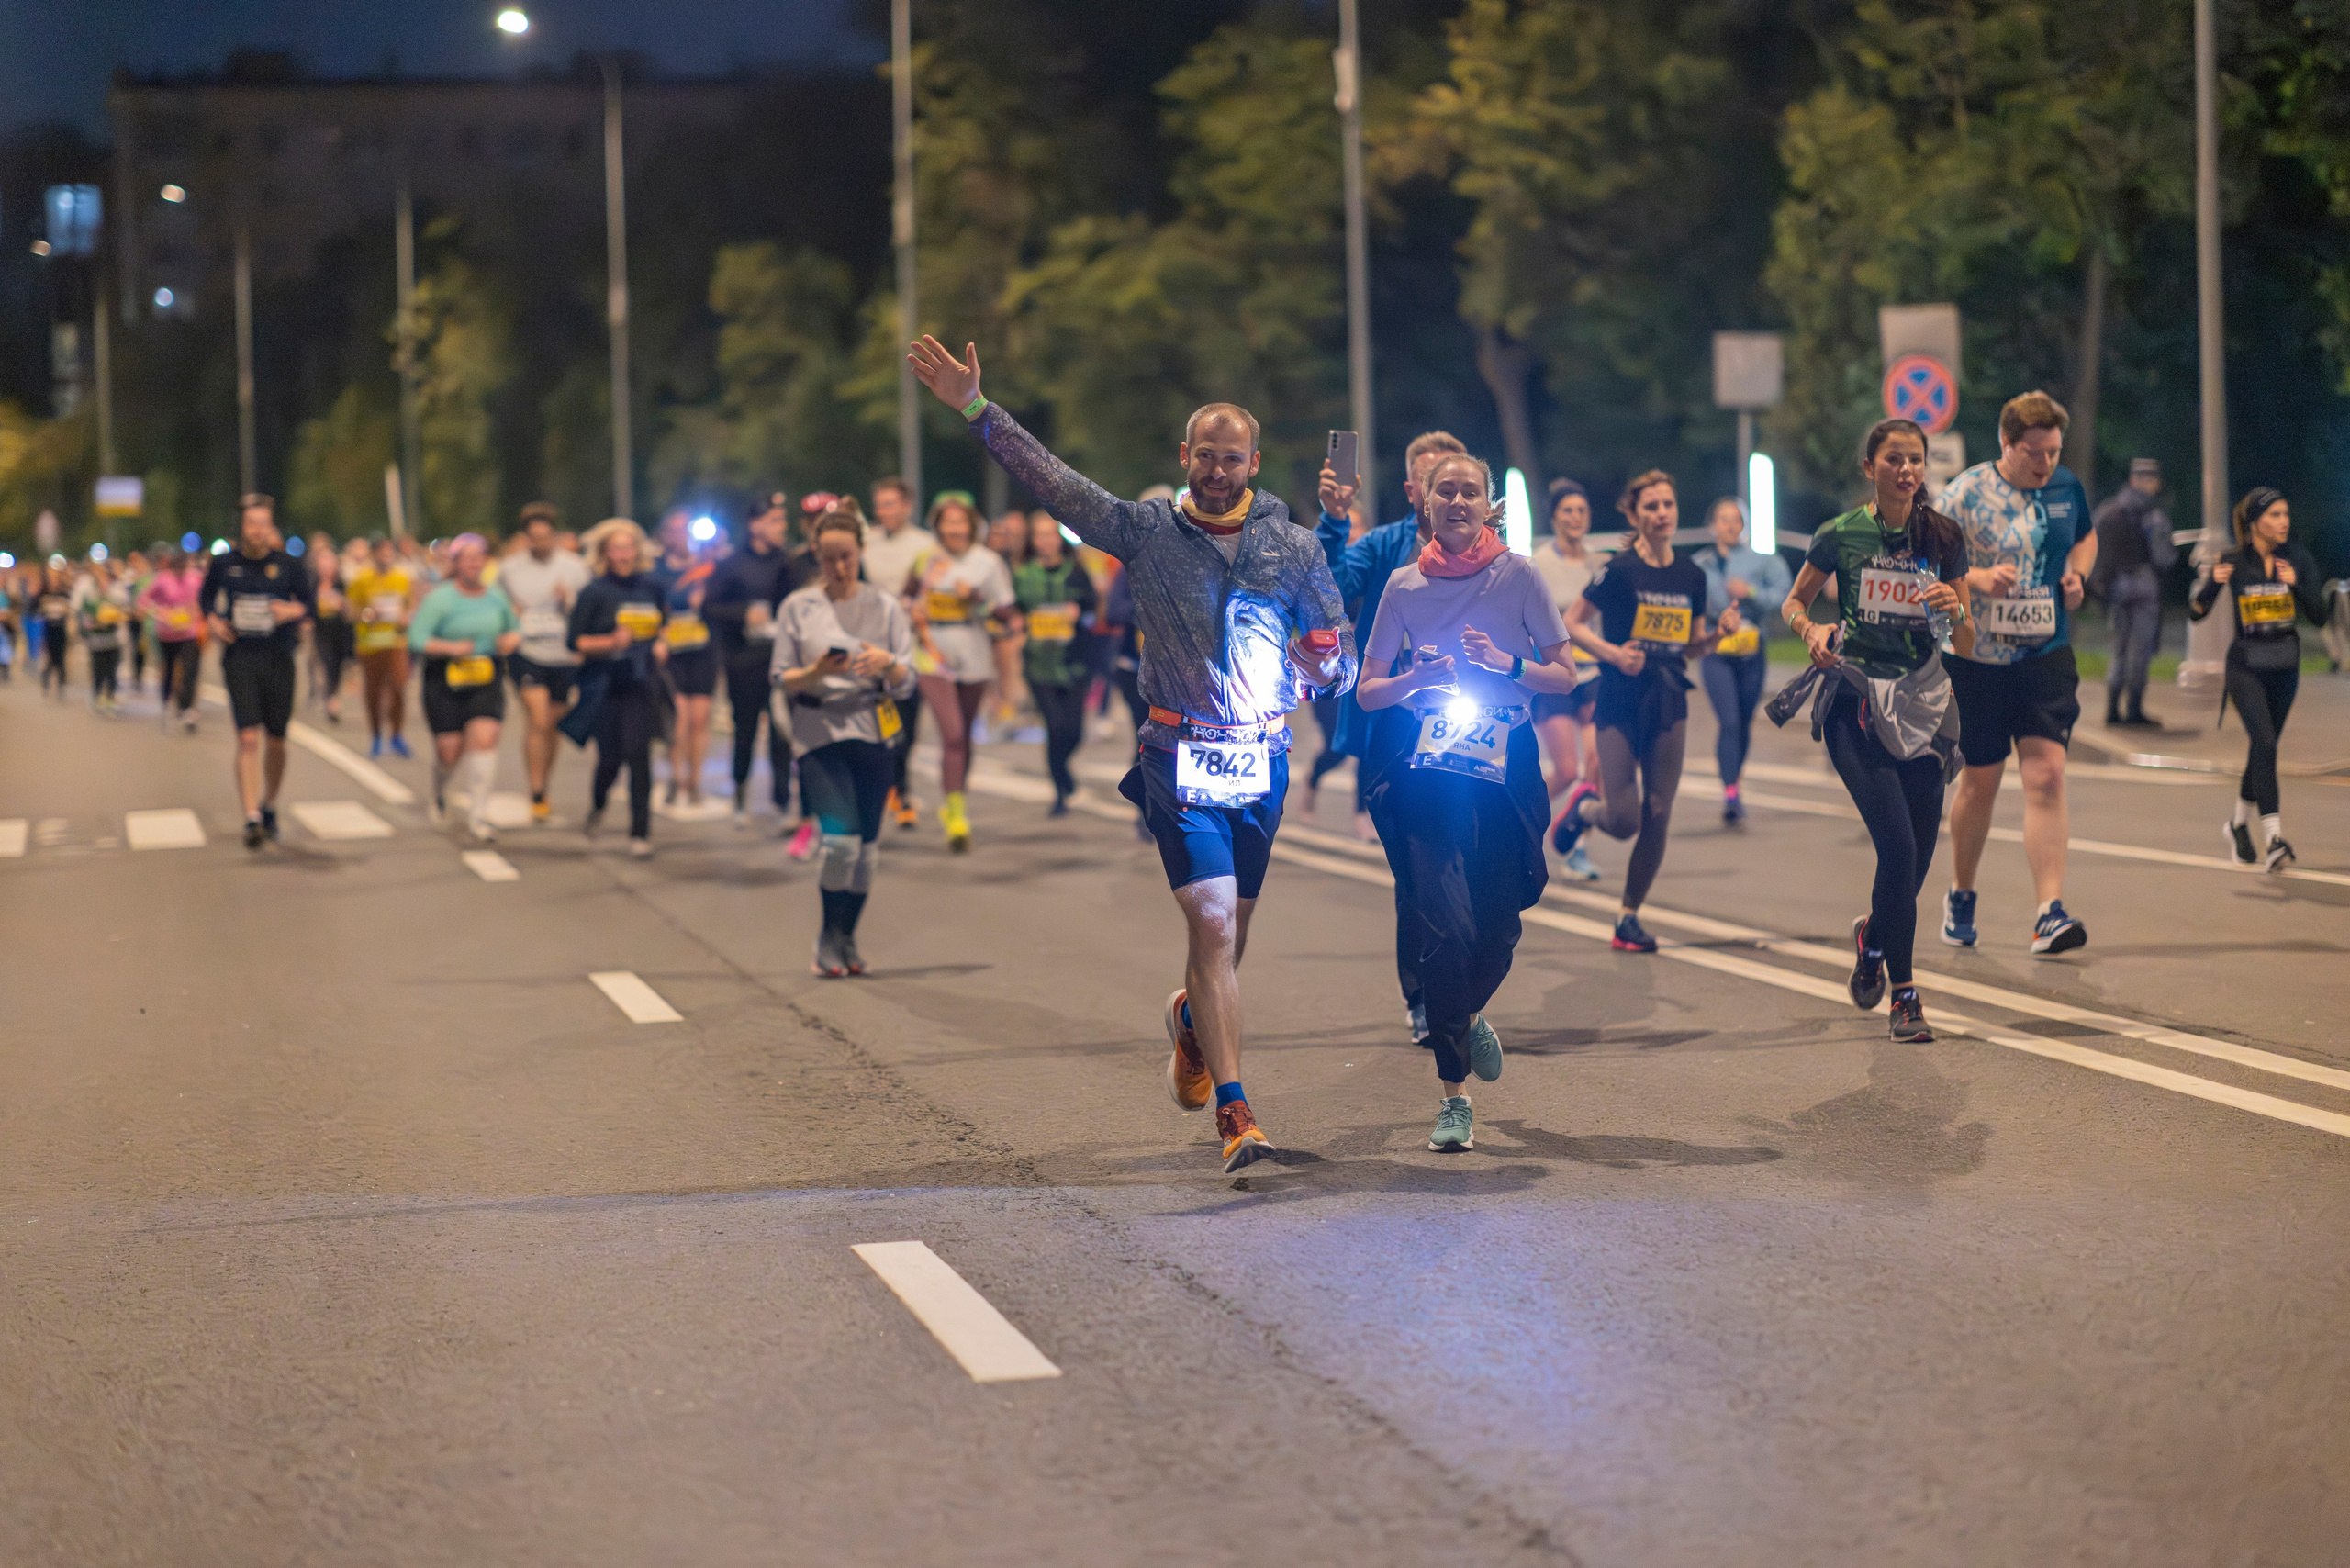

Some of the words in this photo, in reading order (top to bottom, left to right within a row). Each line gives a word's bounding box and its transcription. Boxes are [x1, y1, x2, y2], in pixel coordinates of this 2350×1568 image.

[1644, 612, 1684, 632] 7875
[1997, 604, 2052, 624] 14653
[1431, 720, 1496, 749] 8724
[1190, 749, 1256, 777] 7842
